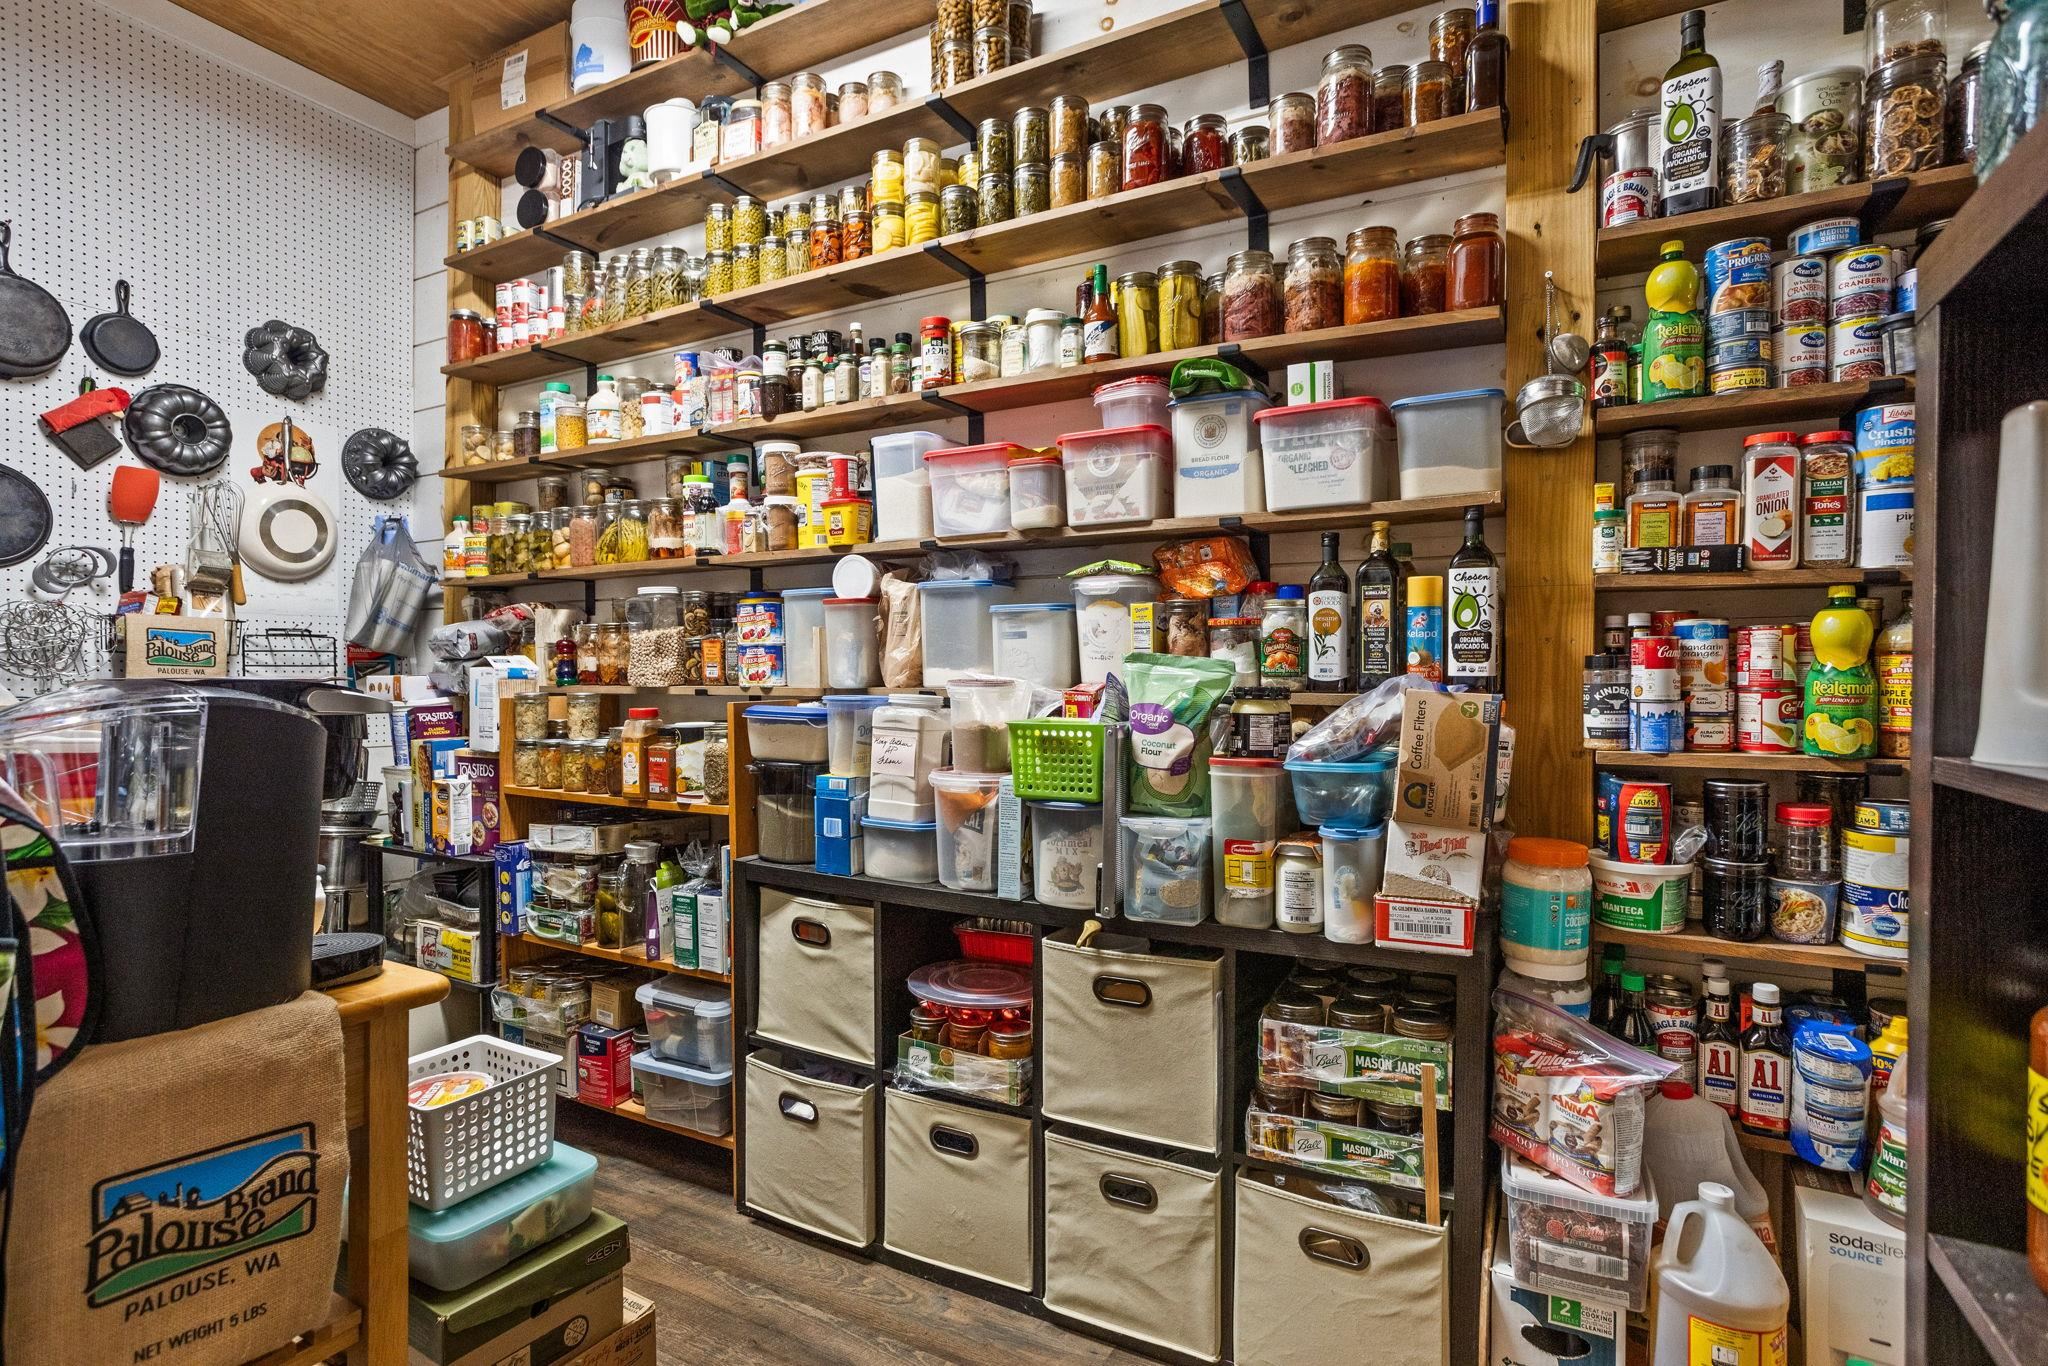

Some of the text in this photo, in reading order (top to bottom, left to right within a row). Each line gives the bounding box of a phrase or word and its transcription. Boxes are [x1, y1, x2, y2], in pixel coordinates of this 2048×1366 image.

[1666, 76, 1710, 94] Chosen
[1819, 90, 1847, 100] Organic
[1672, 146, 1702, 159] ORGANIC
[1665, 152, 1708, 168] AVOCADO OIL
[1623, 182, 1649, 197] BRAND
[1815, 221, 1841, 230] BUMBLE
[1819, 227, 1850, 237] MEDIUM
[1820, 234, 1850, 243] SHRIMP
[1838, 278, 1890, 290] CRANBERRY
[1738, 378, 1765, 386] CLAMS
[1193, 468, 1229, 478] ORGANIC
[1756, 490, 1789, 503] GRANULATED
[1756, 497, 1789, 516] ONION
[1813, 501, 1841, 510] Tone's
[1454, 571, 1491, 583] Chosen
[146, 640, 199, 662] Palouse
[185, 642, 217, 655] Brand
[1453, 642, 1490, 650] AVOCADO OIL
[1682, 651, 1720, 659] oranges
[1812, 681, 1873, 696] ReaLemon
[417, 712, 453, 722] TOASTEDS
[1131, 710, 1169, 723] Organic
[1411, 700, 1427, 770] Coffee Filters
[1142, 739, 1177, 749] Coconut
[1141, 747, 1163, 756] Flour
[458, 762, 495, 778] TOASTEDS
[1427, 798, 1435, 812] you
[1419, 836, 1470, 855] Red Mill
[1602, 902, 1643, 916] MANTECA
[911, 1054, 928, 1066] Ball
[1315, 1053, 1342, 1069] Ball
[1355, 1055, 1422, 1075] MASON JARS
[1523, 1050, 1571, 1069] Ziploc
[1752, 1092, 1780, 1100] ORIGINAL
[1552, 1095, 1600, 1122] ANNA
[1297, 1138, 1321, 1152] Ball
[1342, 1142, 1395, 1160] MASON JARS
[222, 1169, 320, 1221] Brand
[83, 1207, 270, 1295] Palouse
[1829, 1232, 1904, 1259] sodastre
[1829, 1245, 1883, 1266] SOURCE
[124, 1251, 281, 1323] PALOUSE, WA
[1560, 1301, 1571, 1316] 2
[1553, 1314, 1579, 1325] BOTTLES
[1582, 1311, 1613, 1323] COOKING
[134, 1302, 268, 1365] NET WEIGHT 5 LBS
[1582, 1324, 1613, 1336] CLEANING
